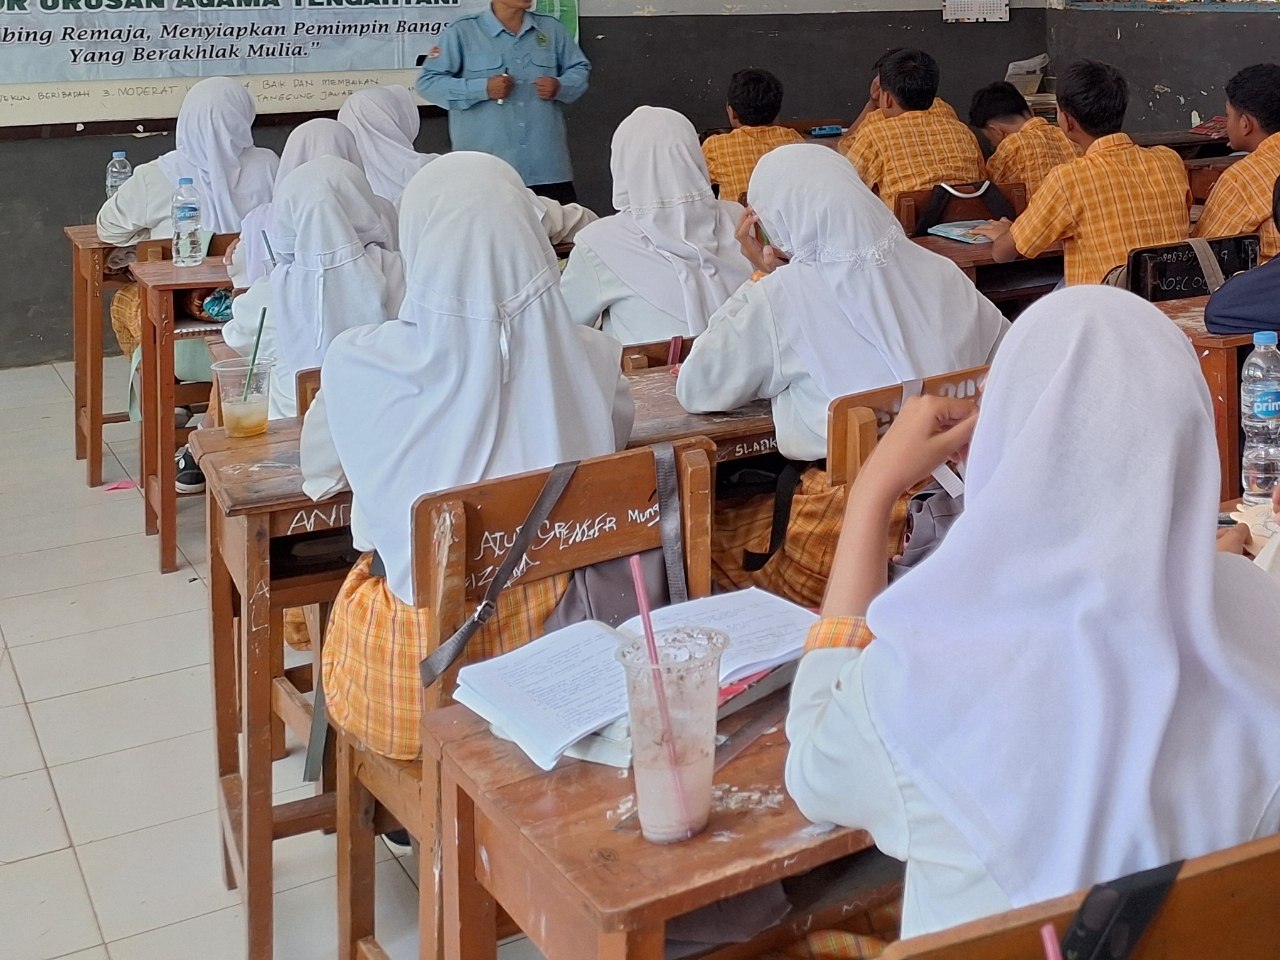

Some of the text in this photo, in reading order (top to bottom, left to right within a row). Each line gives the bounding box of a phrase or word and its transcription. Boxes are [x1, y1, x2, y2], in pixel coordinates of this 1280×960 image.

[62, 24, 151, 42] Remaja,
[159, 22, 286, 41] Menyiapkan
[293, 20, 389, 39] Pemimpin
[69, 47, 125, 65] Yang
[132, 43, 240, 62] Berakhlak
[118, 85, 179, 97] MODERAT
[294, 78, 314, 88] DAN
